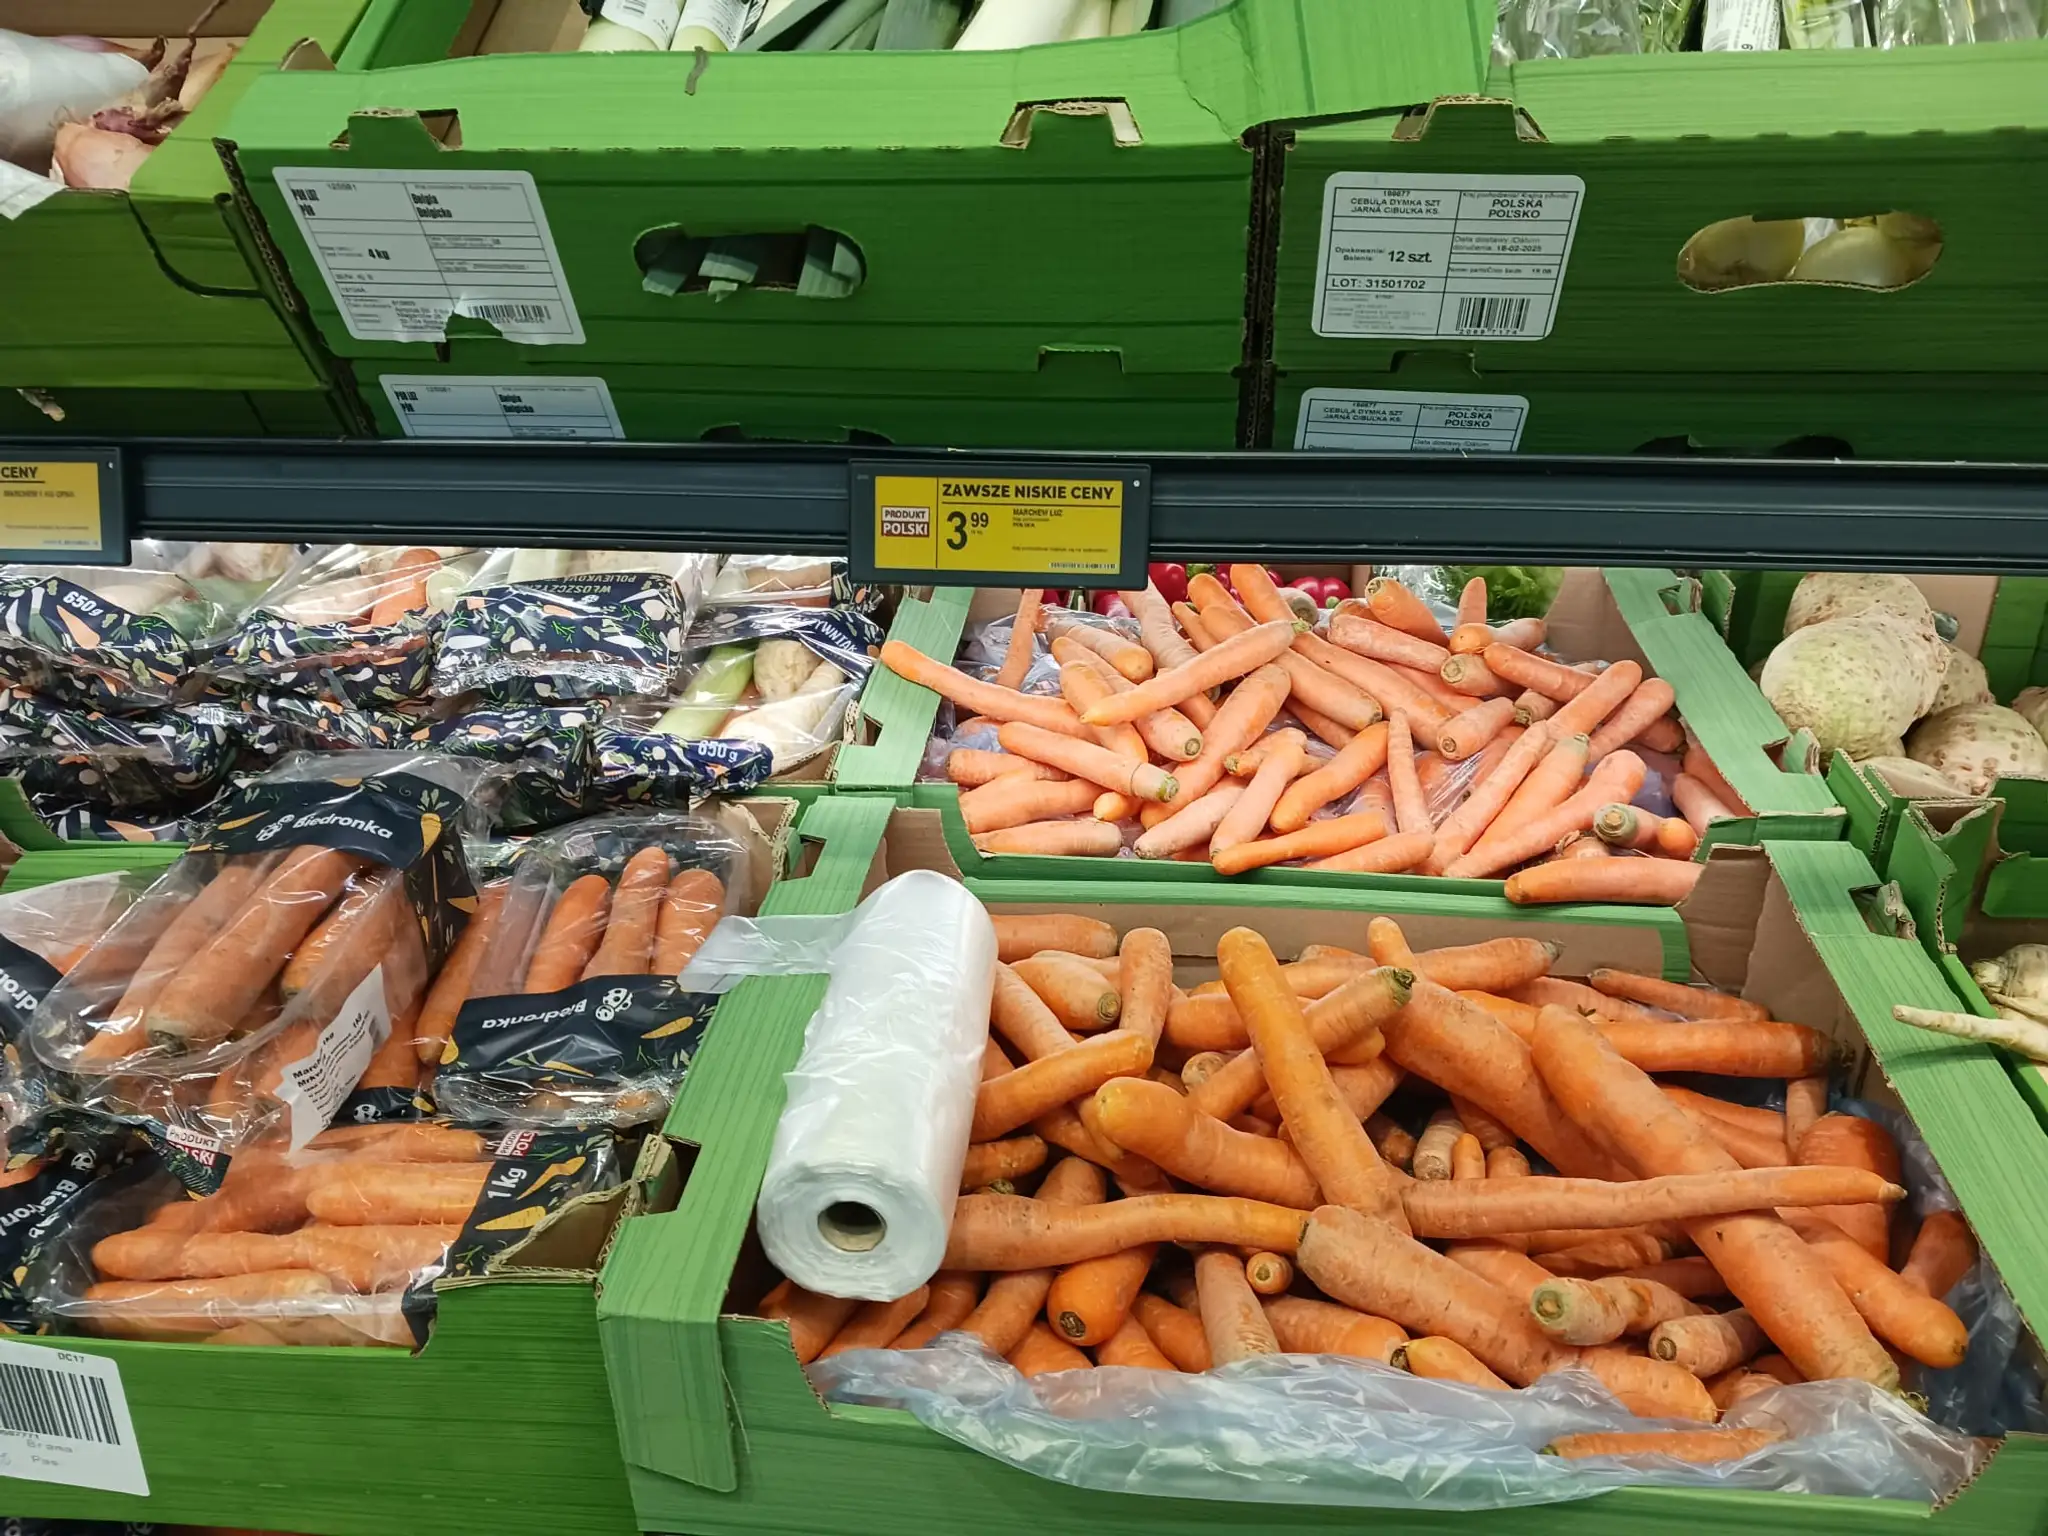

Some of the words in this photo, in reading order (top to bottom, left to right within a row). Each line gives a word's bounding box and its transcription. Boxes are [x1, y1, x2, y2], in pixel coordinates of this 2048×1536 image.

[1350, 198, 1387, 206] CEBULA
[1389, 198, 1422, 206] DYMKA
[1424, 199, 1441, 207] SZT
[1492, 199, 1543, 208] POLSKA
[368, 249, 377, 259] 4
[1388, 251, 1406, 263] 12
[1332, 278, 1362, 288] LOT:
[1365, 279, 1426, 289] 31501702
[1448, 411, 1493, 420] POLSKA
[1, 466, 38, 479] CENY
[942, 483, 1010, 498] ZAWSZE
[1014, 485, 1067, 499] NISKIE
[1071, 486, 1114, 500] CENY
[885, 510, 926, 519] PRODUKT
[1013, 508, 1048, 517] MARCHEW
[883, 523, 928, 536] POLSKI
[946, 511, 968, 551] 3
[970, 512, 989, 528] 99
[293, 813, 394, 840] Biedronka
[482, 998, 588, 1030] Biedronka
[58, 1352, 85, 1363] DC17
